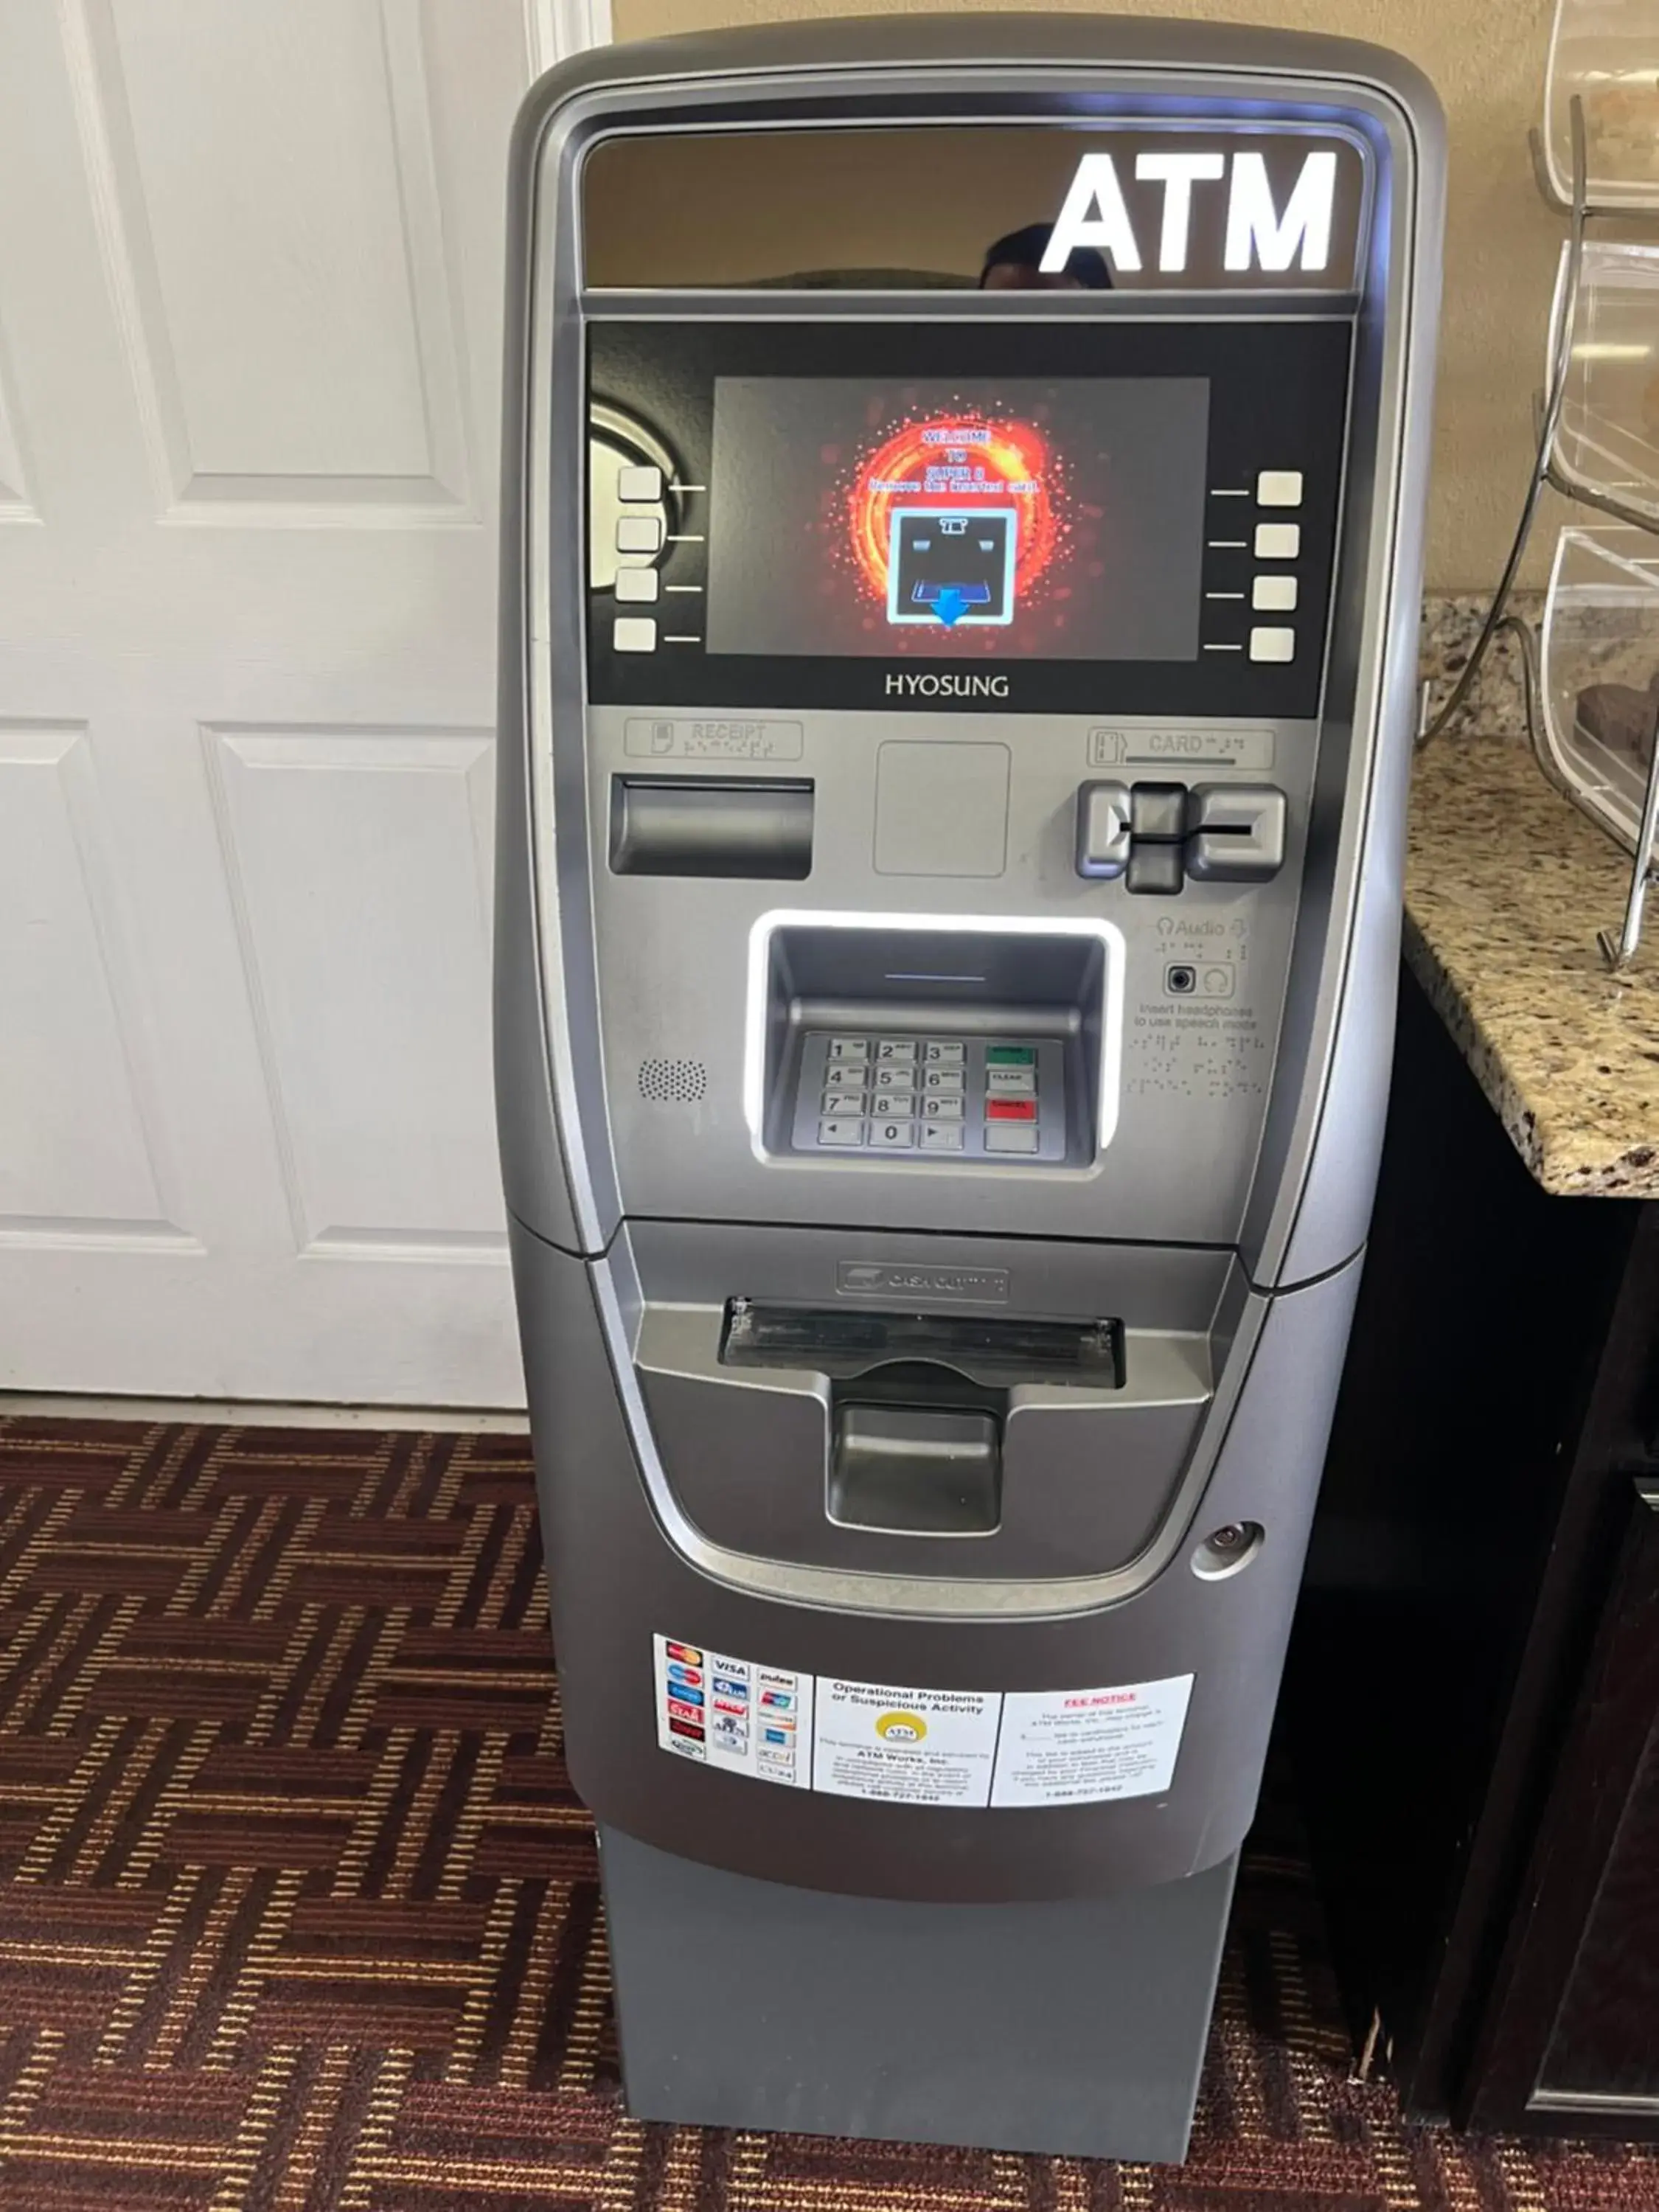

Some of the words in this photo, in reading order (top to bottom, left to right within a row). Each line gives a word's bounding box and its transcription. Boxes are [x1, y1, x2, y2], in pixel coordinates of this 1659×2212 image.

[1038, 152, 1337, 273] ATM
[886, 674, 1009, 697] HYOSUNG
[692, 723, 766, 740] RECEIPT
[1149, 734, 1202, 752] CARD
[1175, 920, 1225, 936] Audio
[834, 1045, 842, 1057] 1
[883, 1046, 894, 1058] 2
[929, 1047, 941, 1060] 3
[831, 1071, 841, 1083] 4
[880, 1072, 891, 1085] 5
[929, 1074, 940, 1085] 6
[829, 1097, 840, 1110] 7
[878, 1099, 889, 1112] 8
[928, 1102, 939, 1113] 9
[885, 1125, 897, 1139] 0
[715, 1660, 746, 1675] VISA
[832, 1682, 914, 1699] Operational
[917, 1691, 984, 1703] Problems
[1092, 1693, 1136, 1705] NOTICE
[850, 1694, 927, 1711] Suspicious
[931, 1704, 984, 1715] Activity
[857, 1750, 884, 1759] ATM
